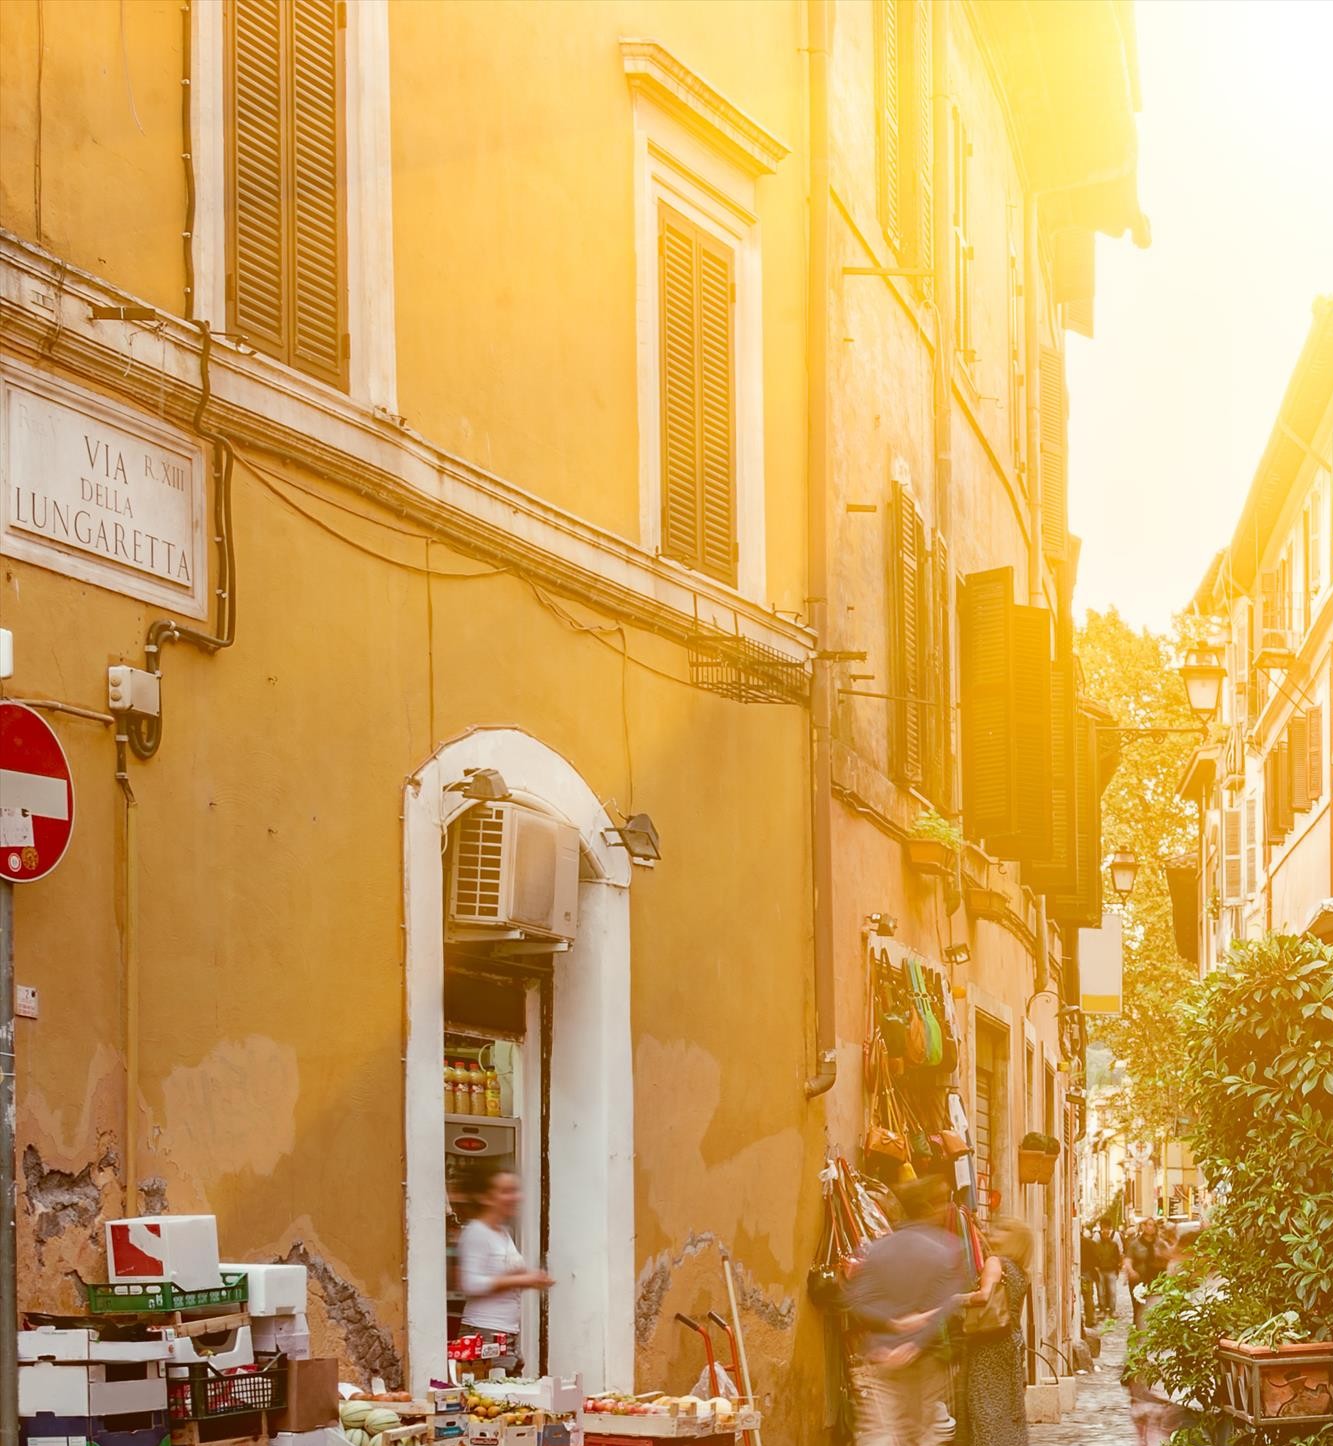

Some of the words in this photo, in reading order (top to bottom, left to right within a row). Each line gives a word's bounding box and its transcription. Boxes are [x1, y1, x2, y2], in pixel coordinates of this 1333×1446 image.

[84, 435, 128, 485] VIA
[80, 477, 133, 518] DELLA
[15, 487, 190, 581] LUNGARETTA
